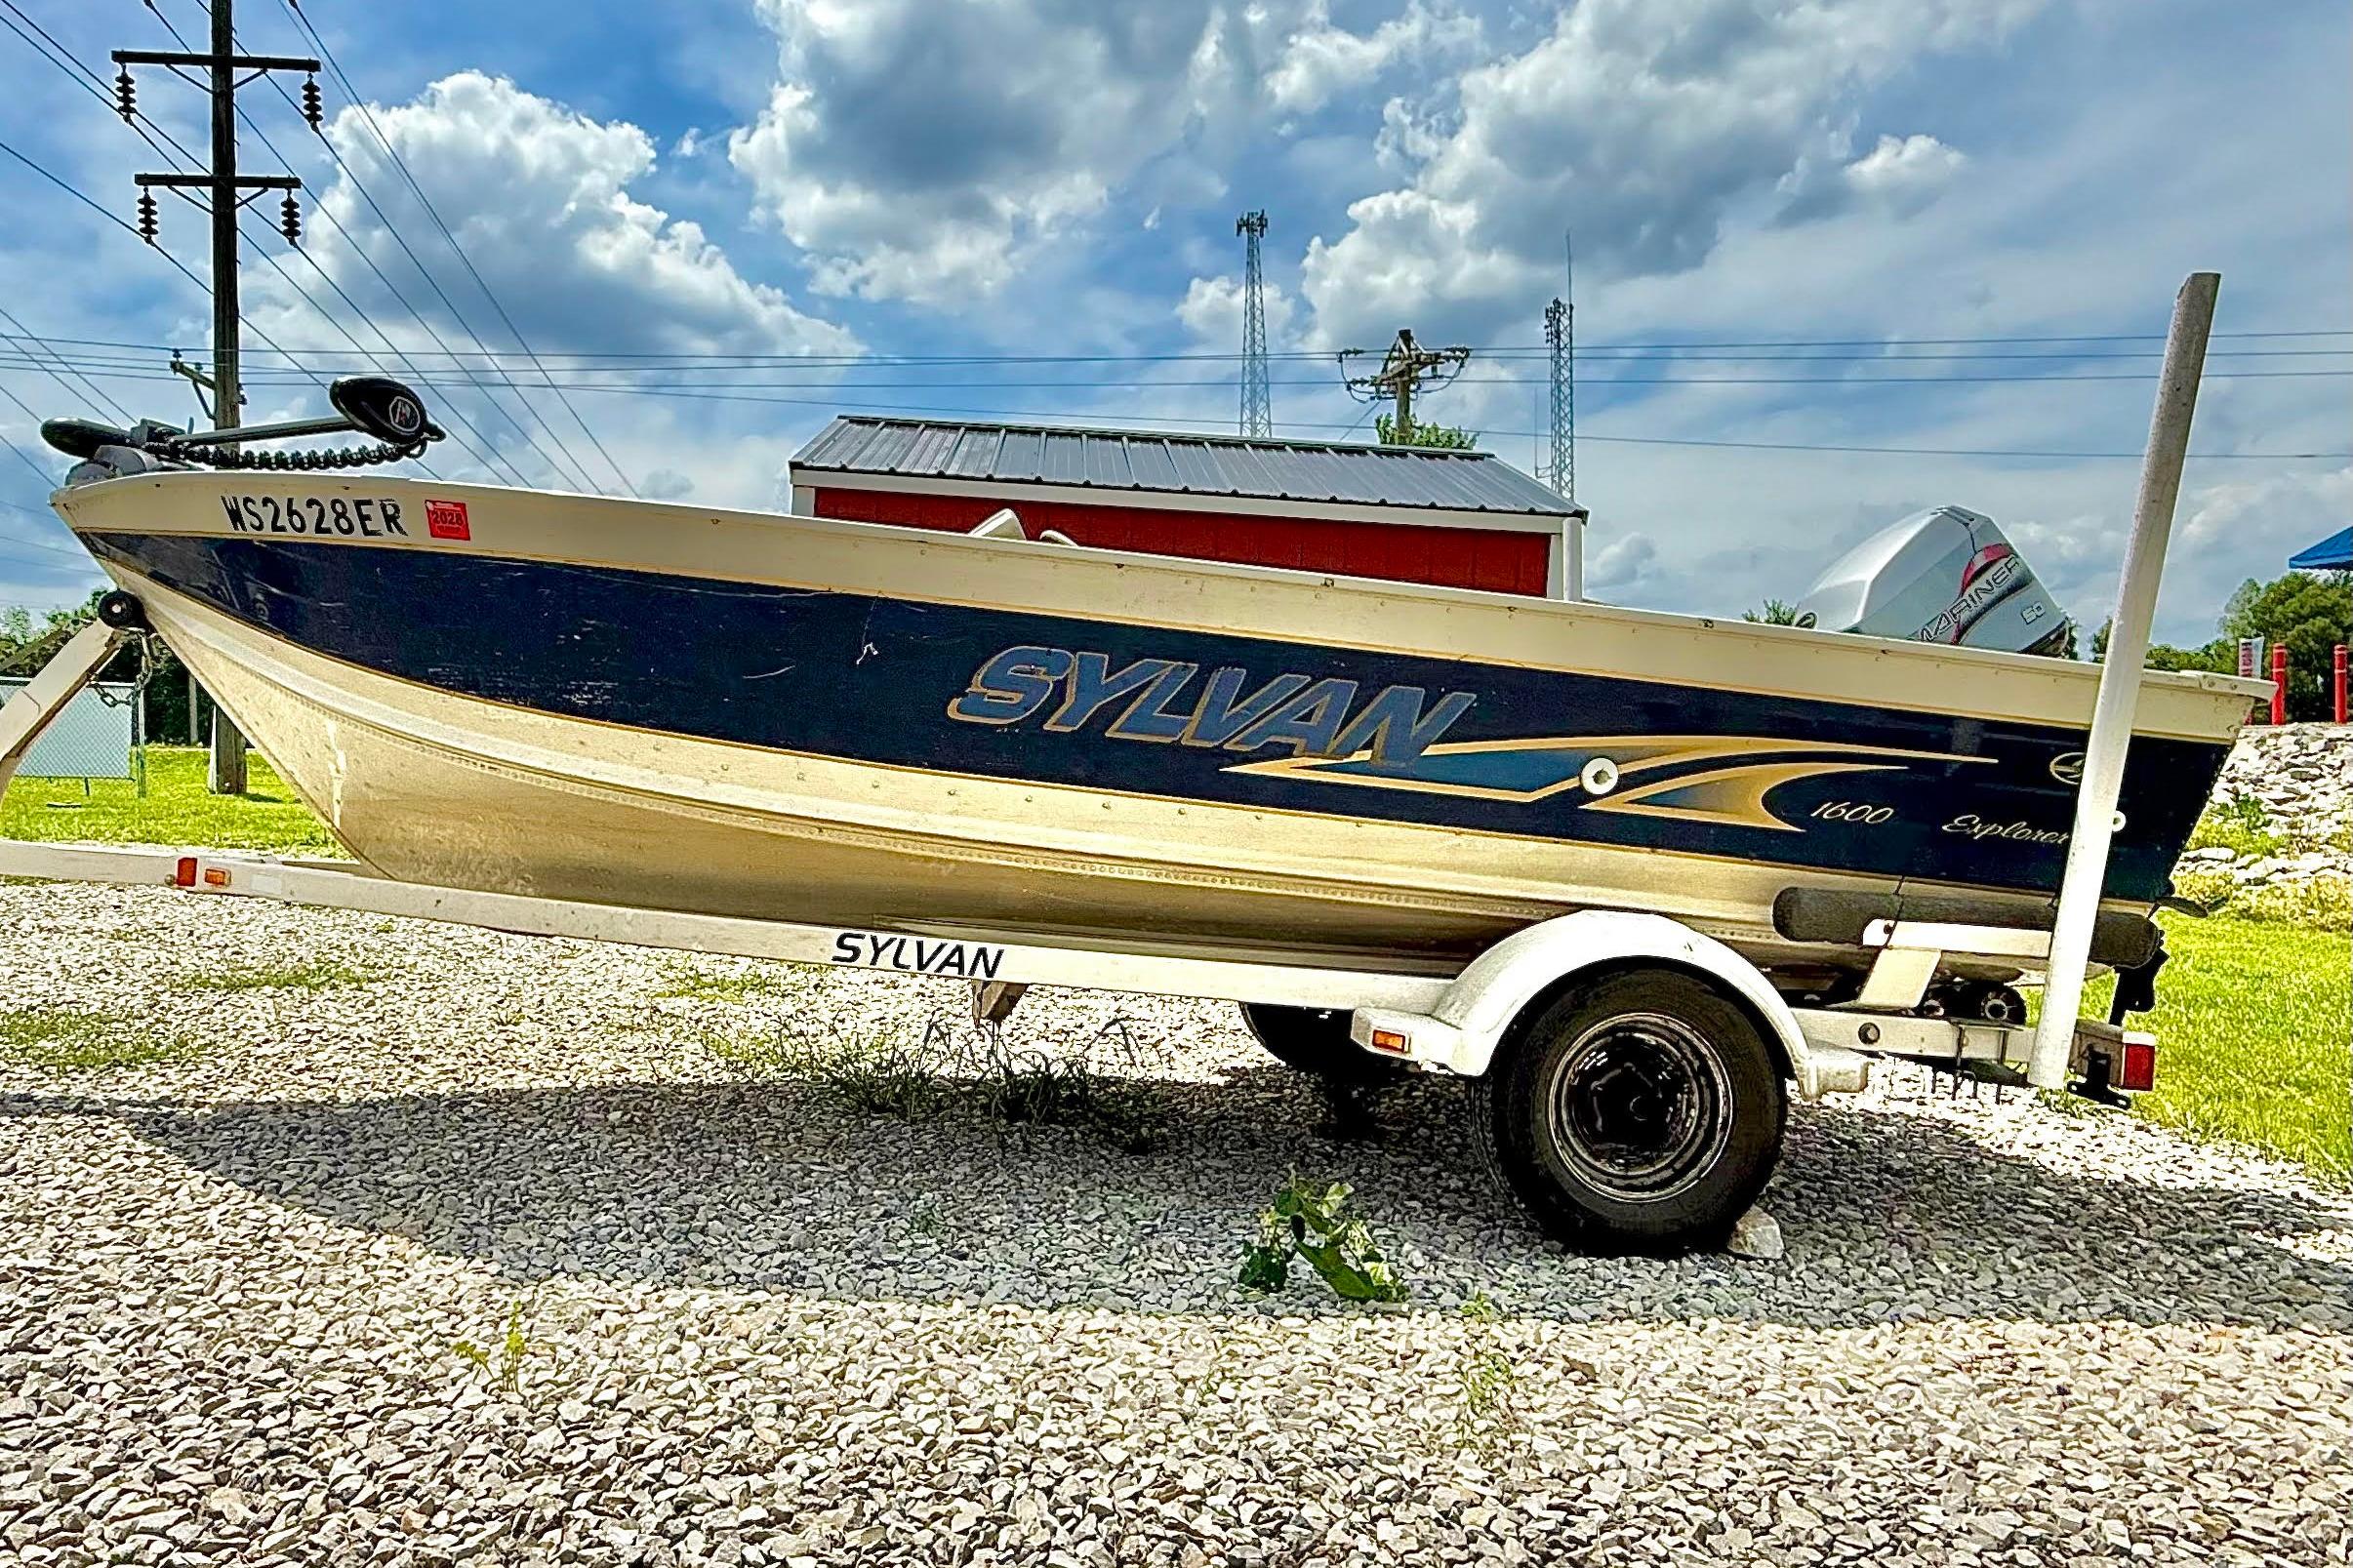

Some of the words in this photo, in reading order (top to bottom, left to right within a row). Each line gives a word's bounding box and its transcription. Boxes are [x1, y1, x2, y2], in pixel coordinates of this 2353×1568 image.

[221, 495, 408, 537] WS2628ER
[947, 644, 1477, 771] SYLVAN
[1810, 801, 1894, 824] 1600
[1942, 814, 2070, 845] Explorer
[832, 932, 1004, 979] SYLVAN
